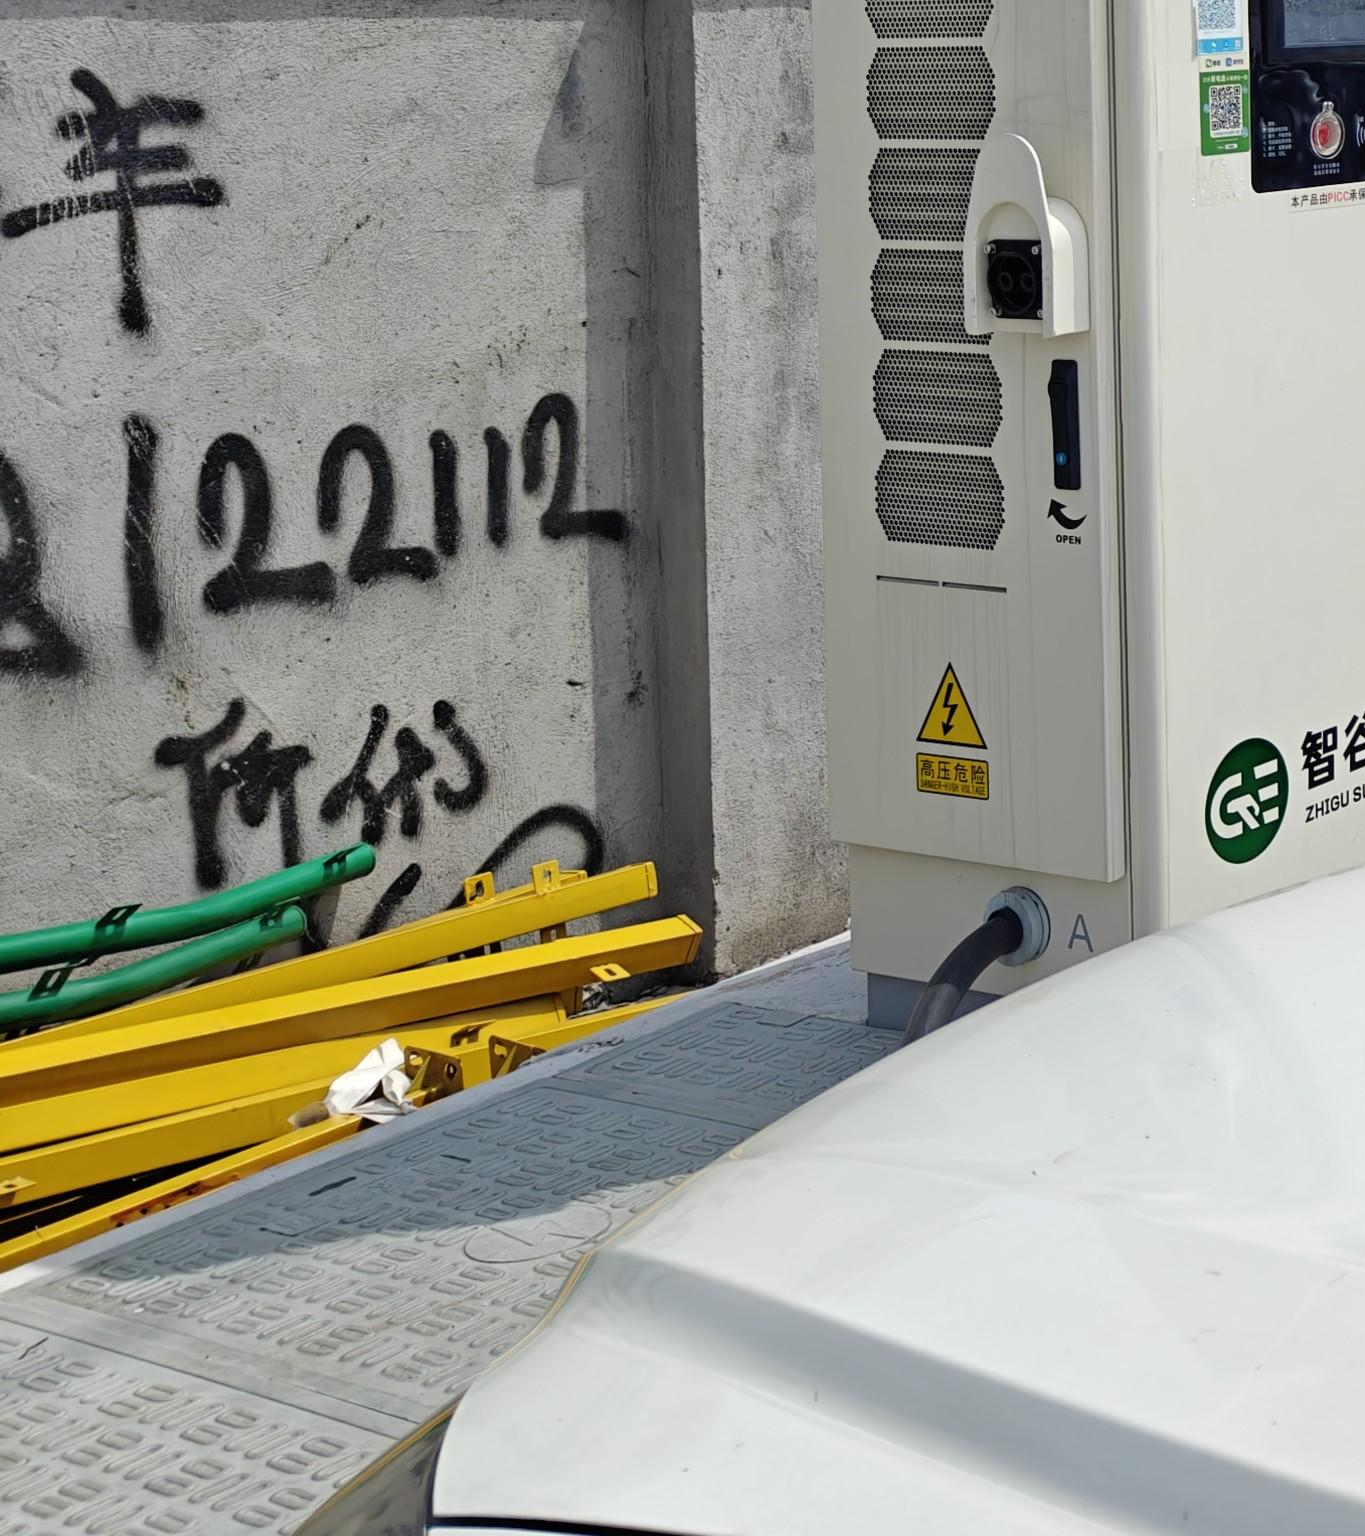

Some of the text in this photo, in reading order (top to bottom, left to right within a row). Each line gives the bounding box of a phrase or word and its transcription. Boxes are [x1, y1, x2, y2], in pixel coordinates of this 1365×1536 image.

[1056, 534, 1082, 545] OPEN
[920, 759, 986, 785] 高压危险
[1305, 789, 1350, 823] ZHIGU
[1068, 913, 1094, 953] A
